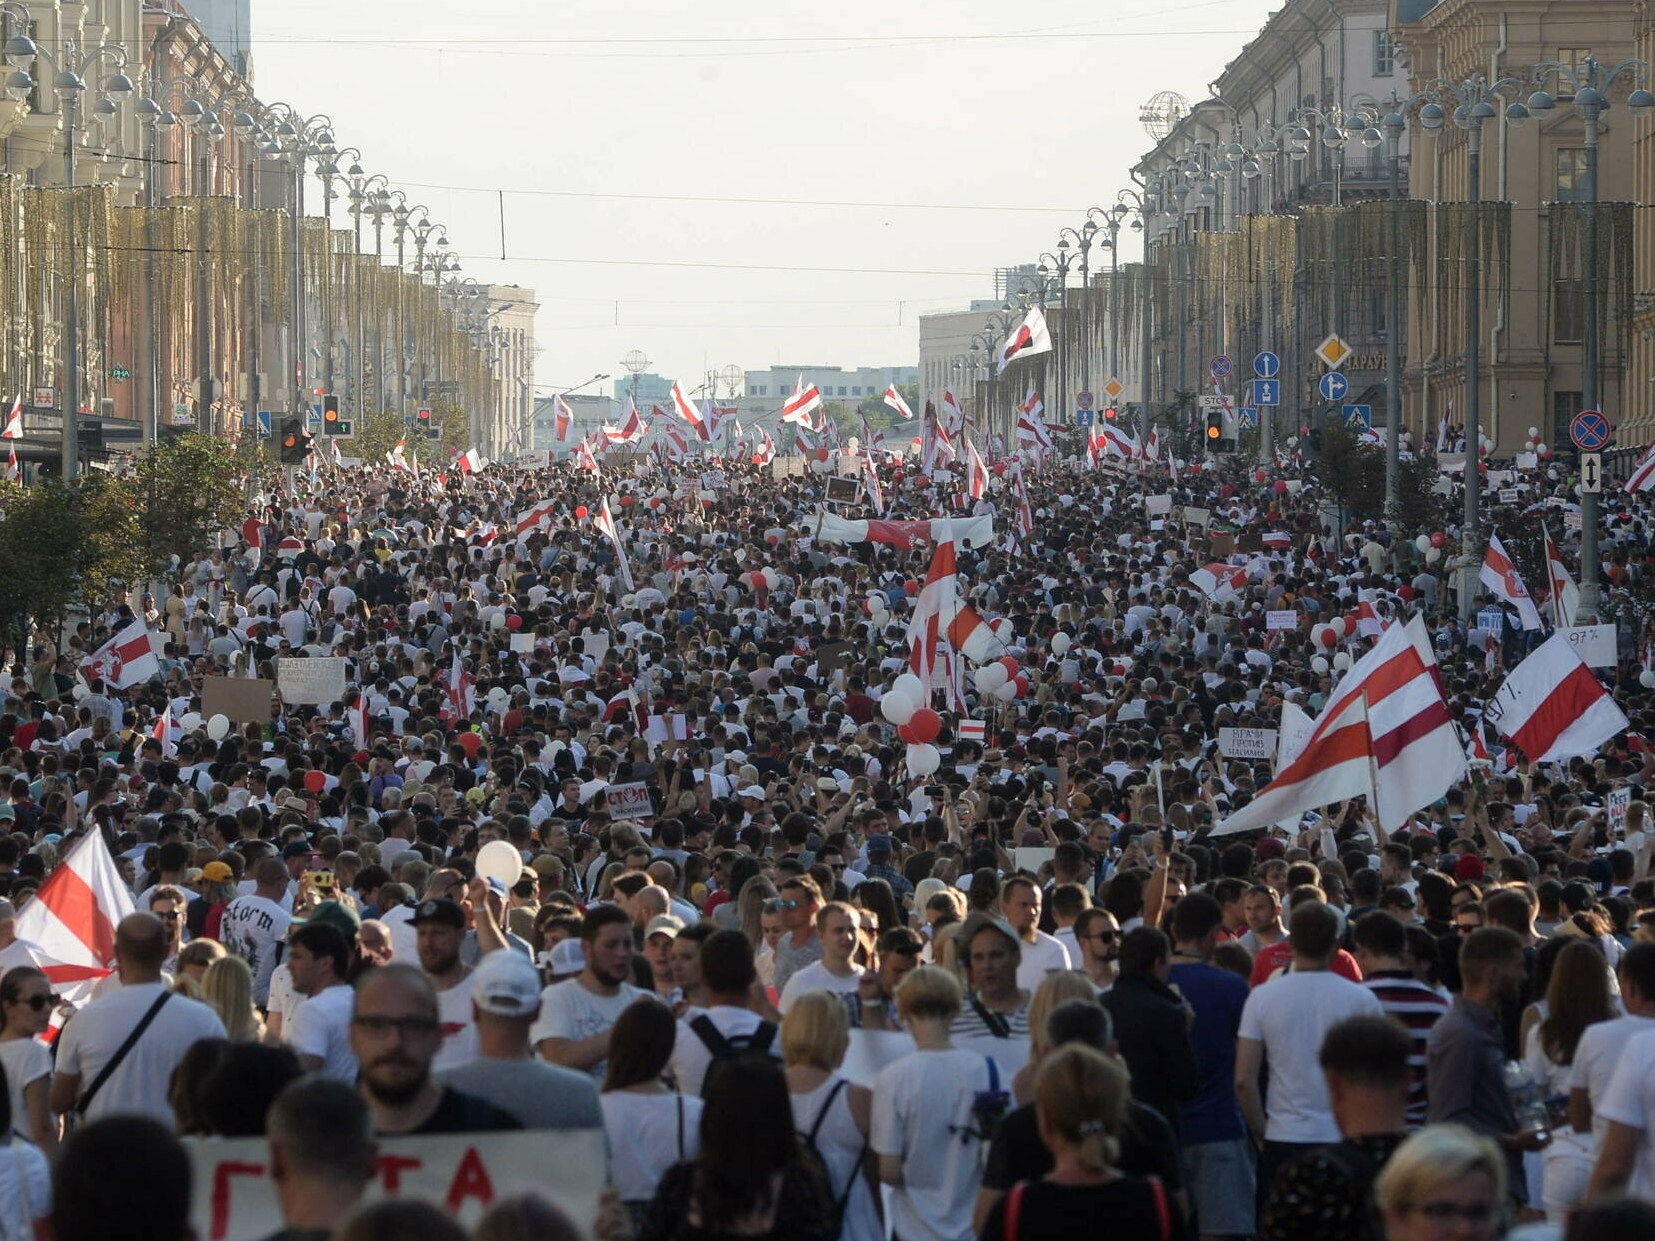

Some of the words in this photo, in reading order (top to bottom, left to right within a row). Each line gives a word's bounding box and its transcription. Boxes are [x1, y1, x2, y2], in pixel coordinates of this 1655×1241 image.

[1232, 728, 1265, 740] ВРАЧИ
[1232, 739, 1265, 750] ПРОТИВ
[210, 1145, 495, 1241] ГТА
